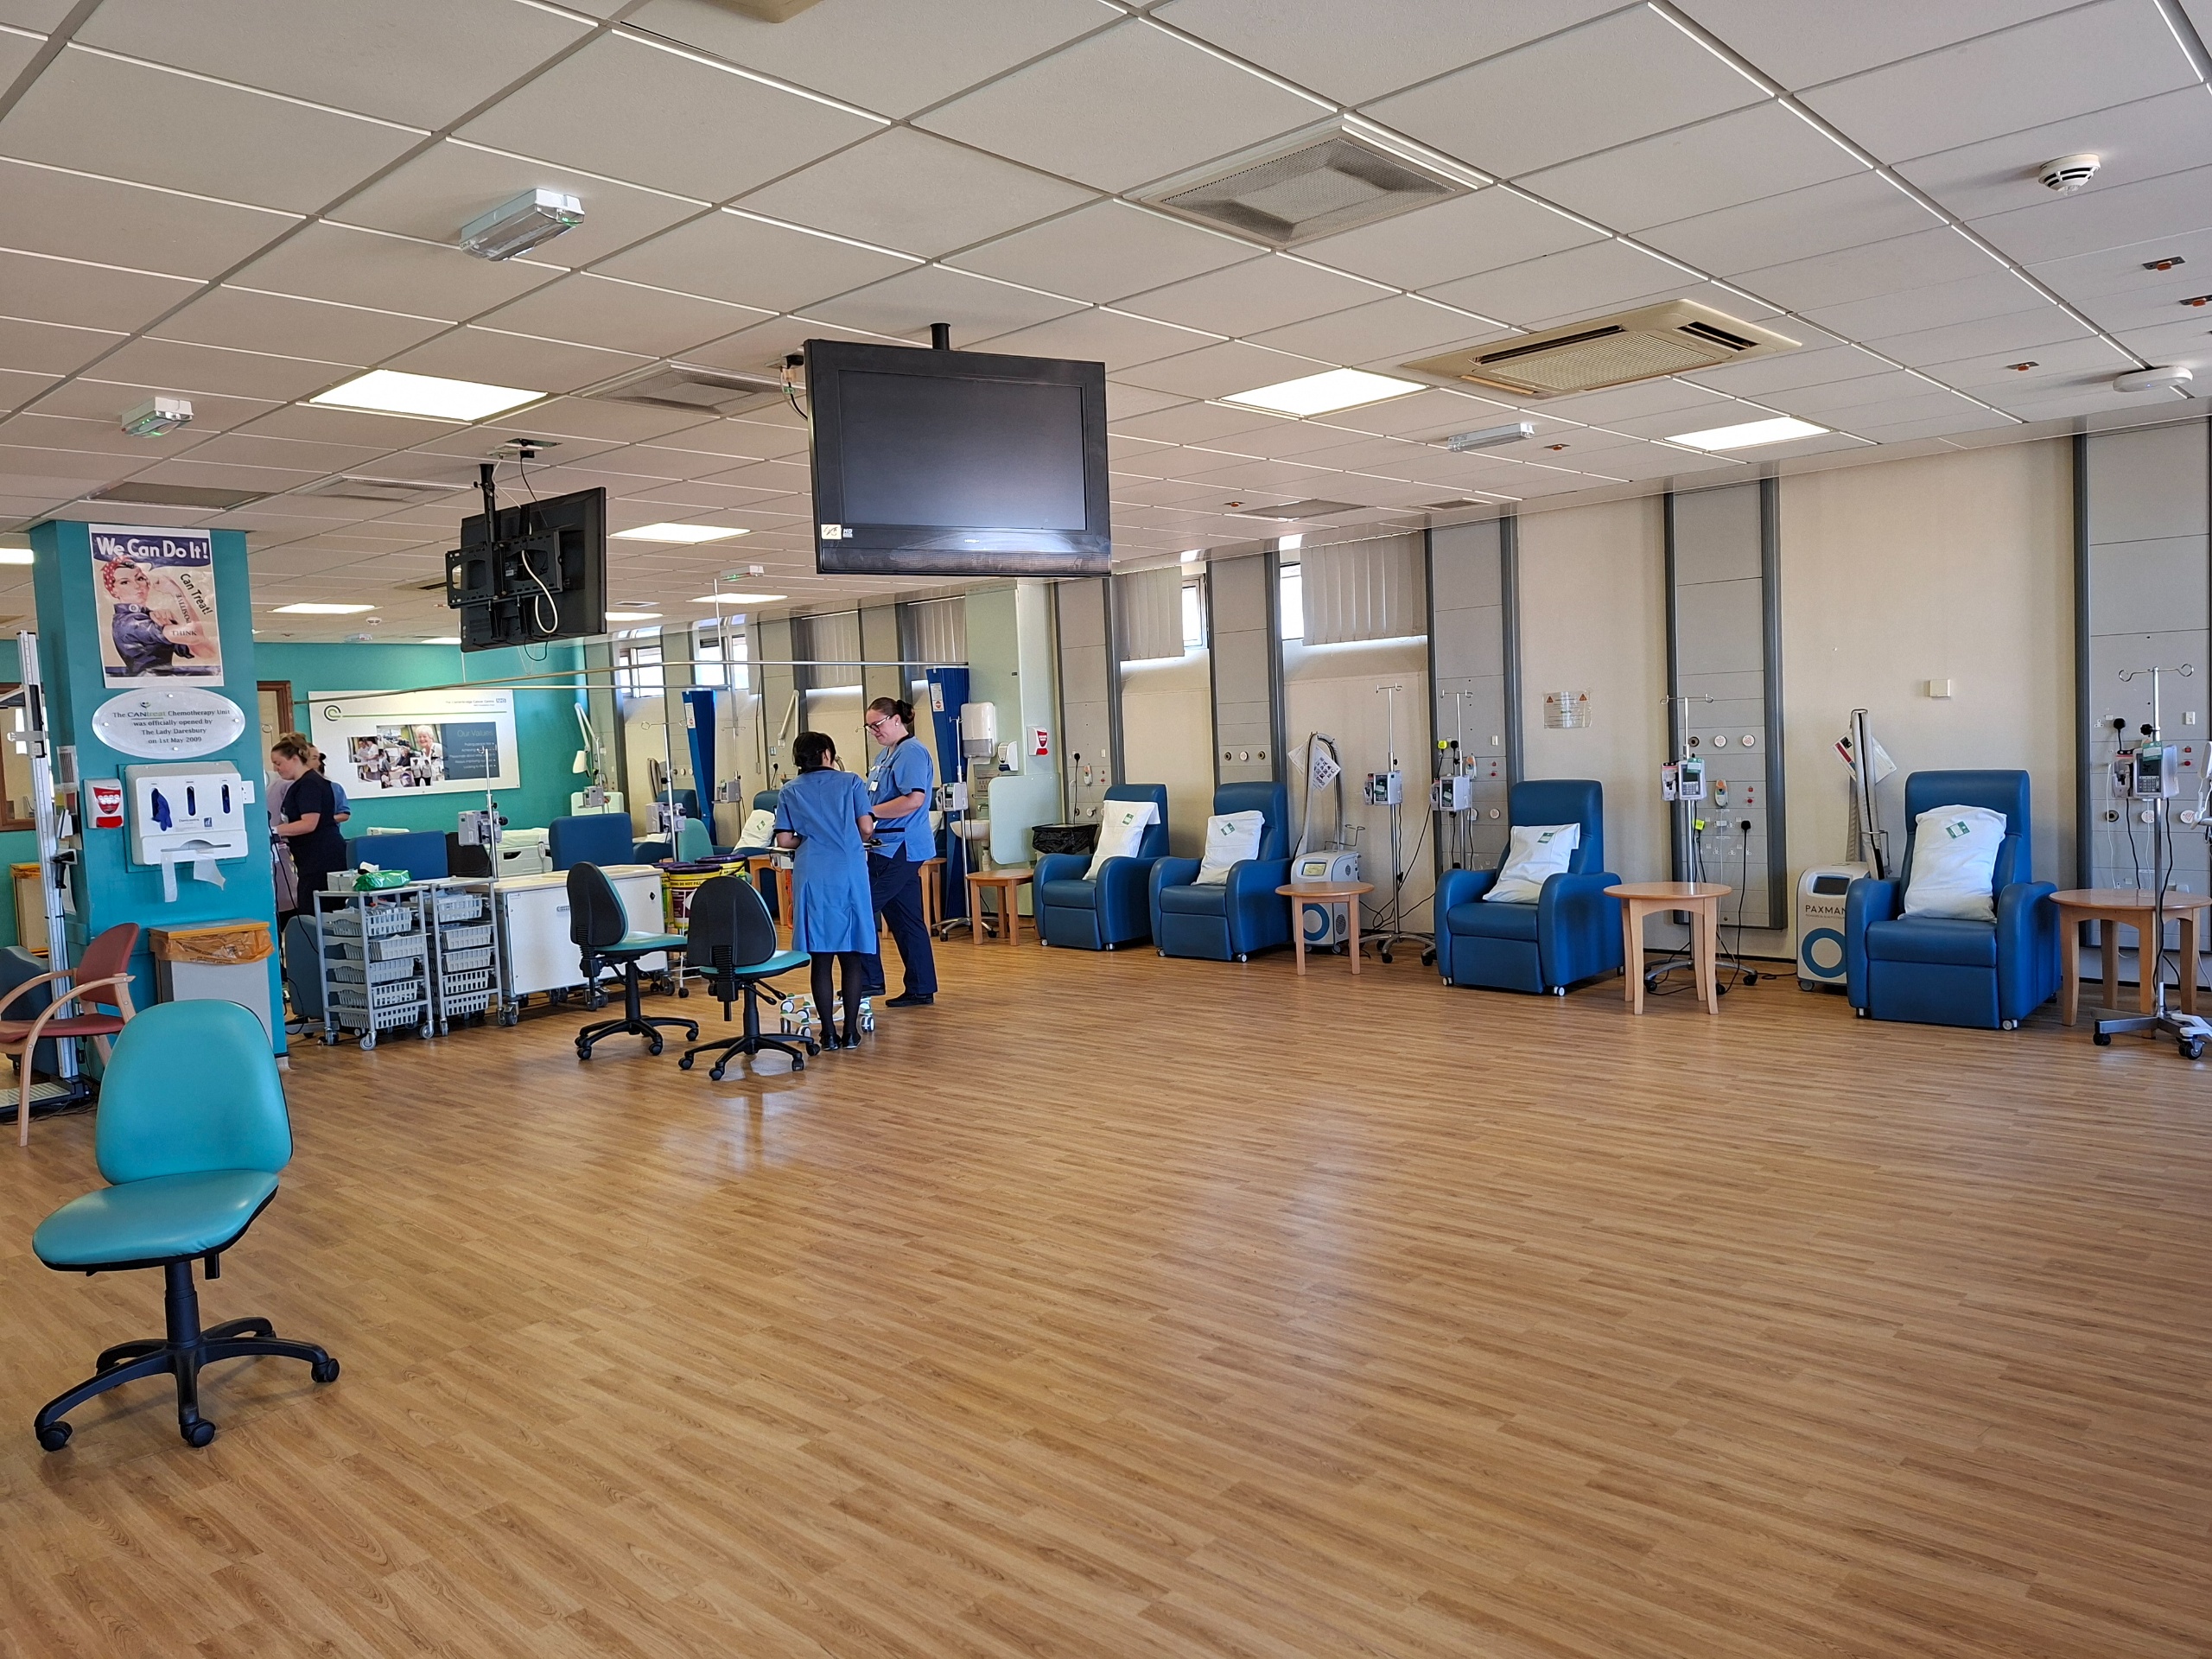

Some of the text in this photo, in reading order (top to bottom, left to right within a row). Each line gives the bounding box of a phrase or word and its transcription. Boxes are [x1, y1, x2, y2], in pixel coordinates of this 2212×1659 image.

[96, 537, 208, 559] We Can Do It!
[180, 573, 213, 615] Can Treat!
[175, 593, 192, 624] POSITIVE
[1805, 905, 1846, 915] PAXMAN
